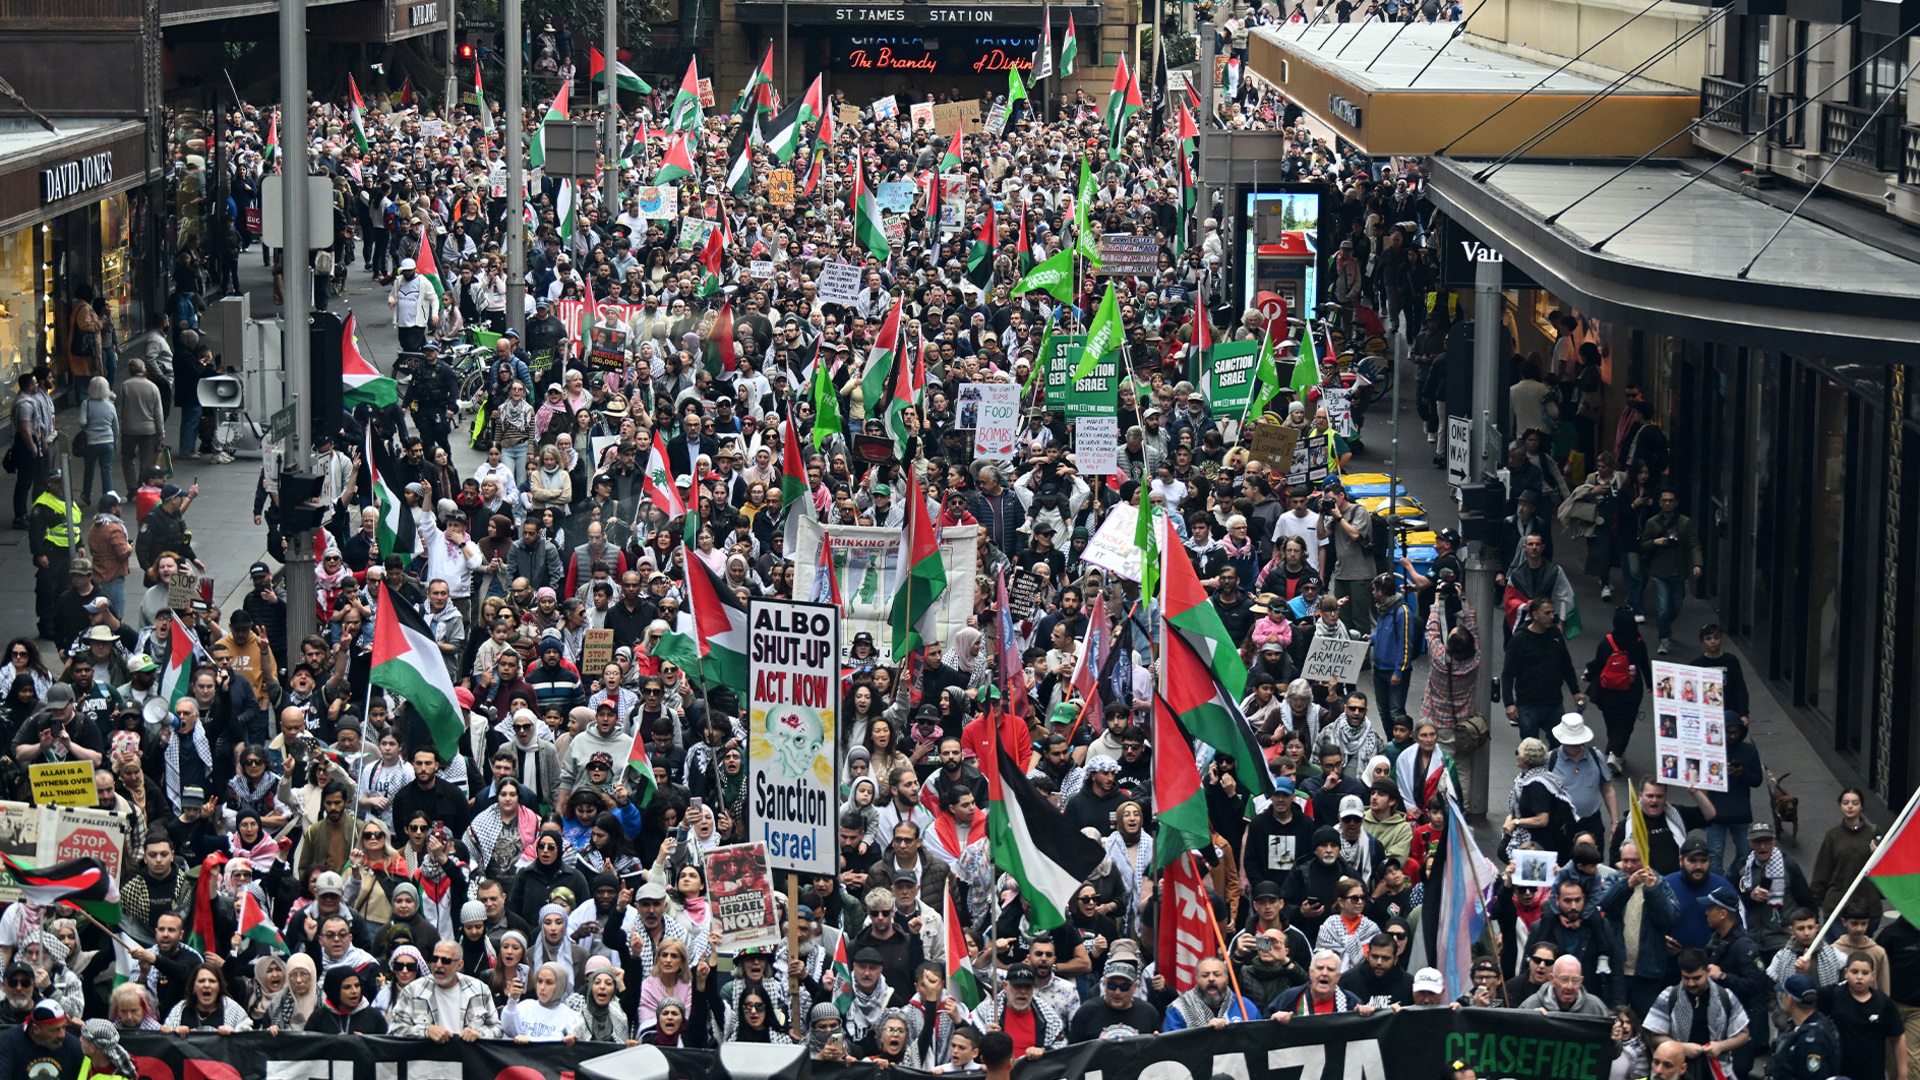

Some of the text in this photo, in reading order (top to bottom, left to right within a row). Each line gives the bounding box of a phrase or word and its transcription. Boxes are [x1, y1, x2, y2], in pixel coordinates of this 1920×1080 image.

[836, 9, 993, 22] ST JAMES STATION
[849, 49, 872, 69] The
[876, 47, 937, 73] Brandy
[973, 52, 988, 73] of
[46, 151, 113, 203] DAVID JONES
[770, 171, 793, 182] AID
[769, 192, 793, 203] BOMBS
[592, 349, 625, 362] MURDERING
[1068, 363, 1115, 377] SCTION
[1214, 355, 1254, 374] SANCTION
[1076, 378, 1109, 392] ISRAEL
[1219, 370, 1247, 388] ISRAEL
[984, 405, 1014, 419] FOOD
[1097, 405, 1114, 413] GREENS
[978, 427, 1013, 443] BOMBS
[1257, 425, 1288, 441] Sanction
[1451, 423, 1467, 443] ONE
[1450, 445, 1468, 464] WAY
[1101, 532, 1123, 545] YOU
[1094, 551, 1106, 560] IT
[170, 574, 196, 589] STOP
[754, 608, 831, 637] ALBO
[588, 632, 609, 640] STOP
[752, 633, 831, 670] SHUT-UP
[1320, 639, 1351, 653] STOP
[588, 651, 606, 659] STOP
[1308, 651, 1354, 665] ARMING
[585, 664, 605, 672] ISRA
[1307, 664, 1348, 679] ISRAEL
[792, 673, 829, 709] NOW
[40, 769, 66, 777] ALLAH
[33, 777, 93, 788] WITNESS OVER
[40, 788, 89, 798] ALL THINGS.
[755, 770, 827, 828] Sanction
[62, 815, 80, 824] FREE
[72, 834, 107, 848] STOP
[764, 821, 817, 862] Israel
[58, 846, 118, 864] ISRAEL'S
[719, 890, 763, 905] SANCTION
[720, 900, 764, 916] ISRAEL
[722, 911, 766, 932] NOW
[1445, 1032, 1602, 1080] CEASEFIRE
